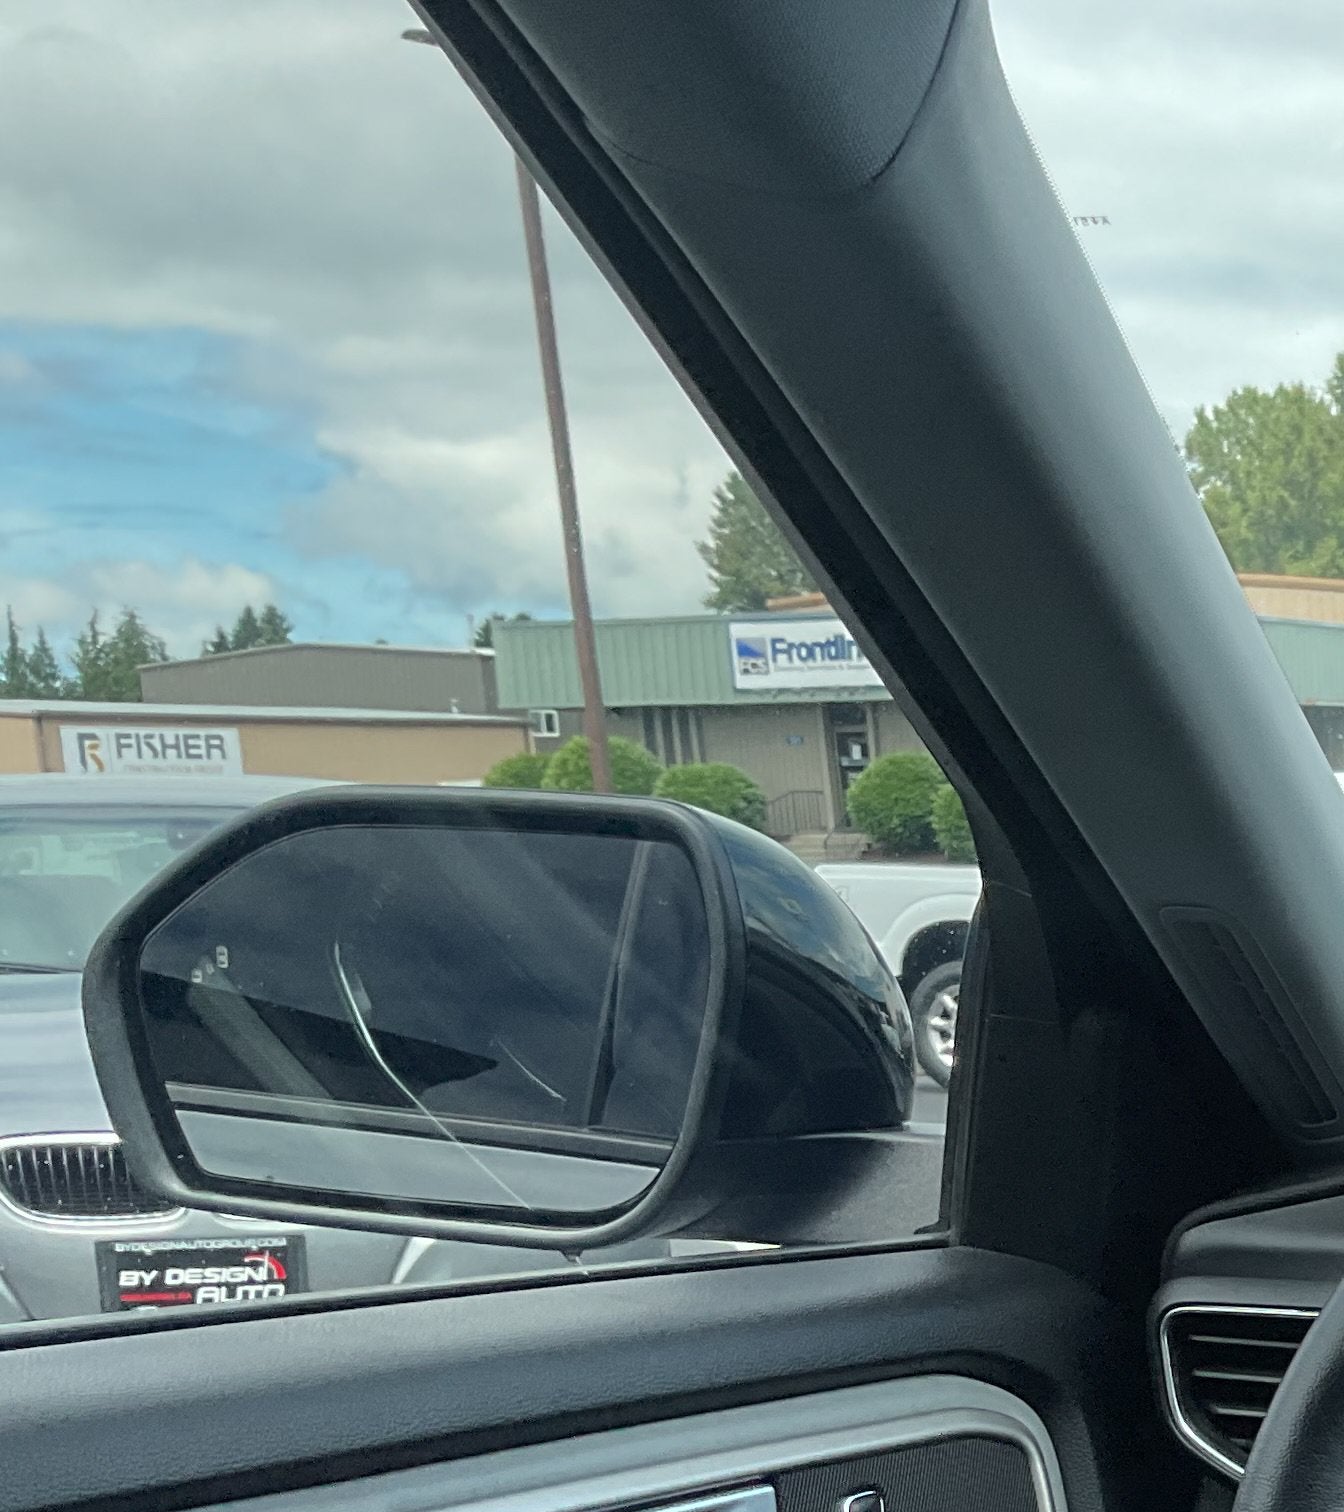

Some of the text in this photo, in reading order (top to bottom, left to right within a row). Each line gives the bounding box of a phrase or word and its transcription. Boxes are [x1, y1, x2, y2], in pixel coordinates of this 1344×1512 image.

[771, 634, 863, 664] Frontlin
[114, 732, 227, 760] FISHER
[118, 1266, 265, 1287] BY DESIGN
[195, 1283, 286, 1305] AUTO
